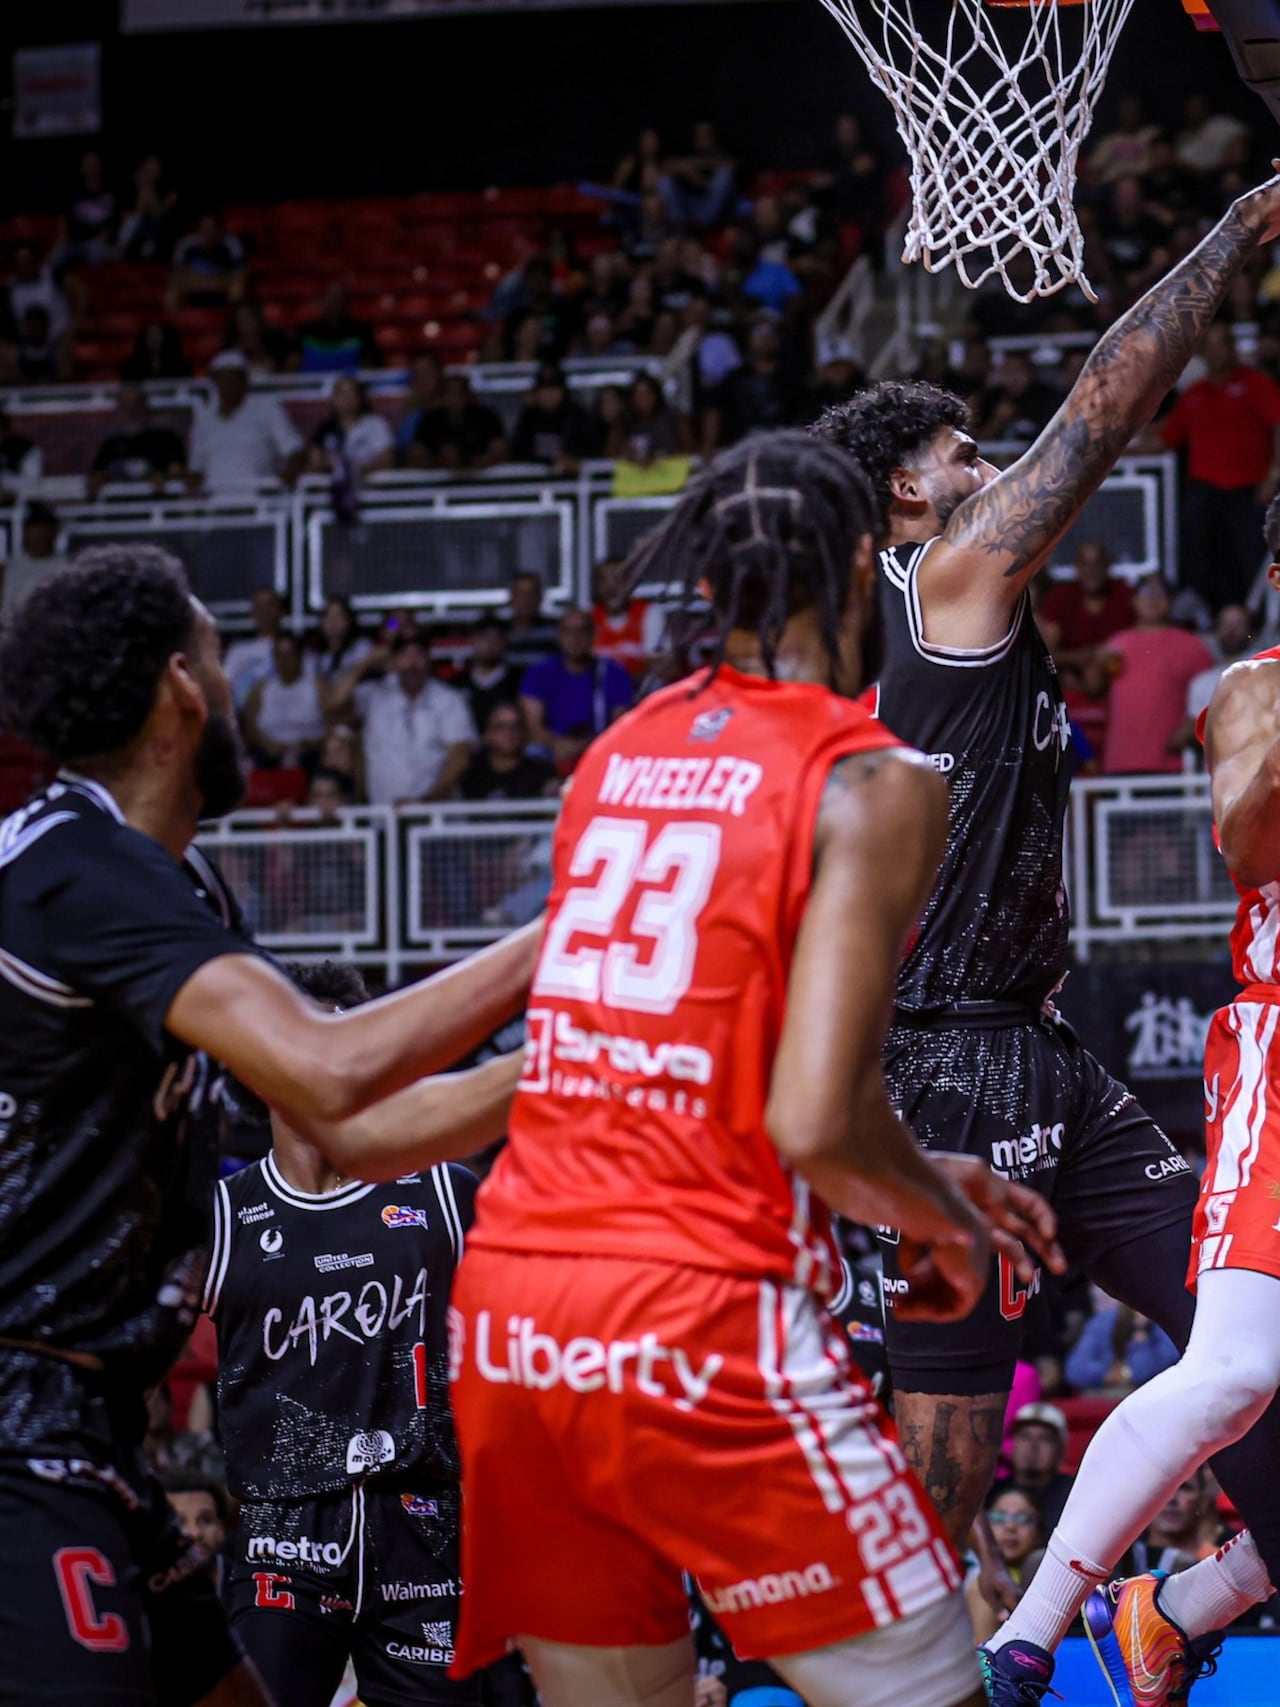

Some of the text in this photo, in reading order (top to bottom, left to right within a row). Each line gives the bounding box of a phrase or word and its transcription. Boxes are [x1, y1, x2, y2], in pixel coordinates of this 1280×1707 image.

[598, 753, 762, 816] WHEELER
[533, 817, 721, 1014] 23
[475, 1310, 724, 1412] Liberty
[247, 1536, 342, 1566] metro
[846, 1480, 931, 1575] 23
[53, 1546, 130, 1652] C
[381, 1579, 456, 1601] Walmart
